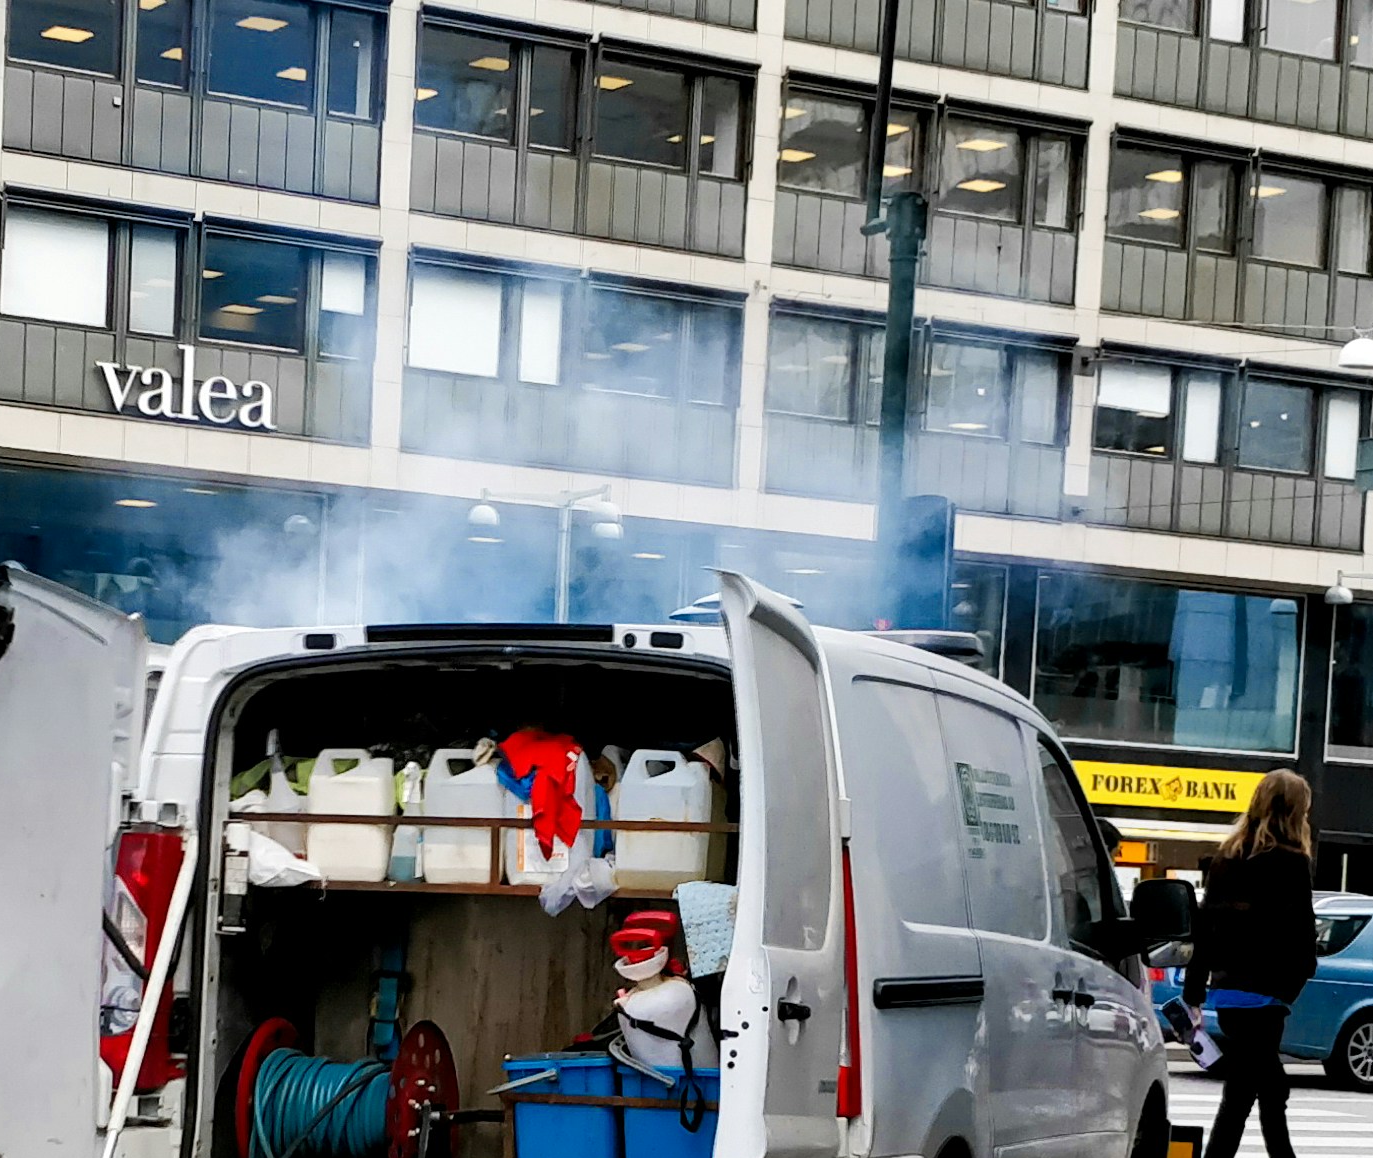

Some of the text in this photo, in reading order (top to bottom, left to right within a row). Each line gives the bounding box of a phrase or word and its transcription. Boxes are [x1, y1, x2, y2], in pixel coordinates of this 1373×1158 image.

[95, 344, 277, 429] valea
[1091, 773, 1237, 801] FOREX BANK
